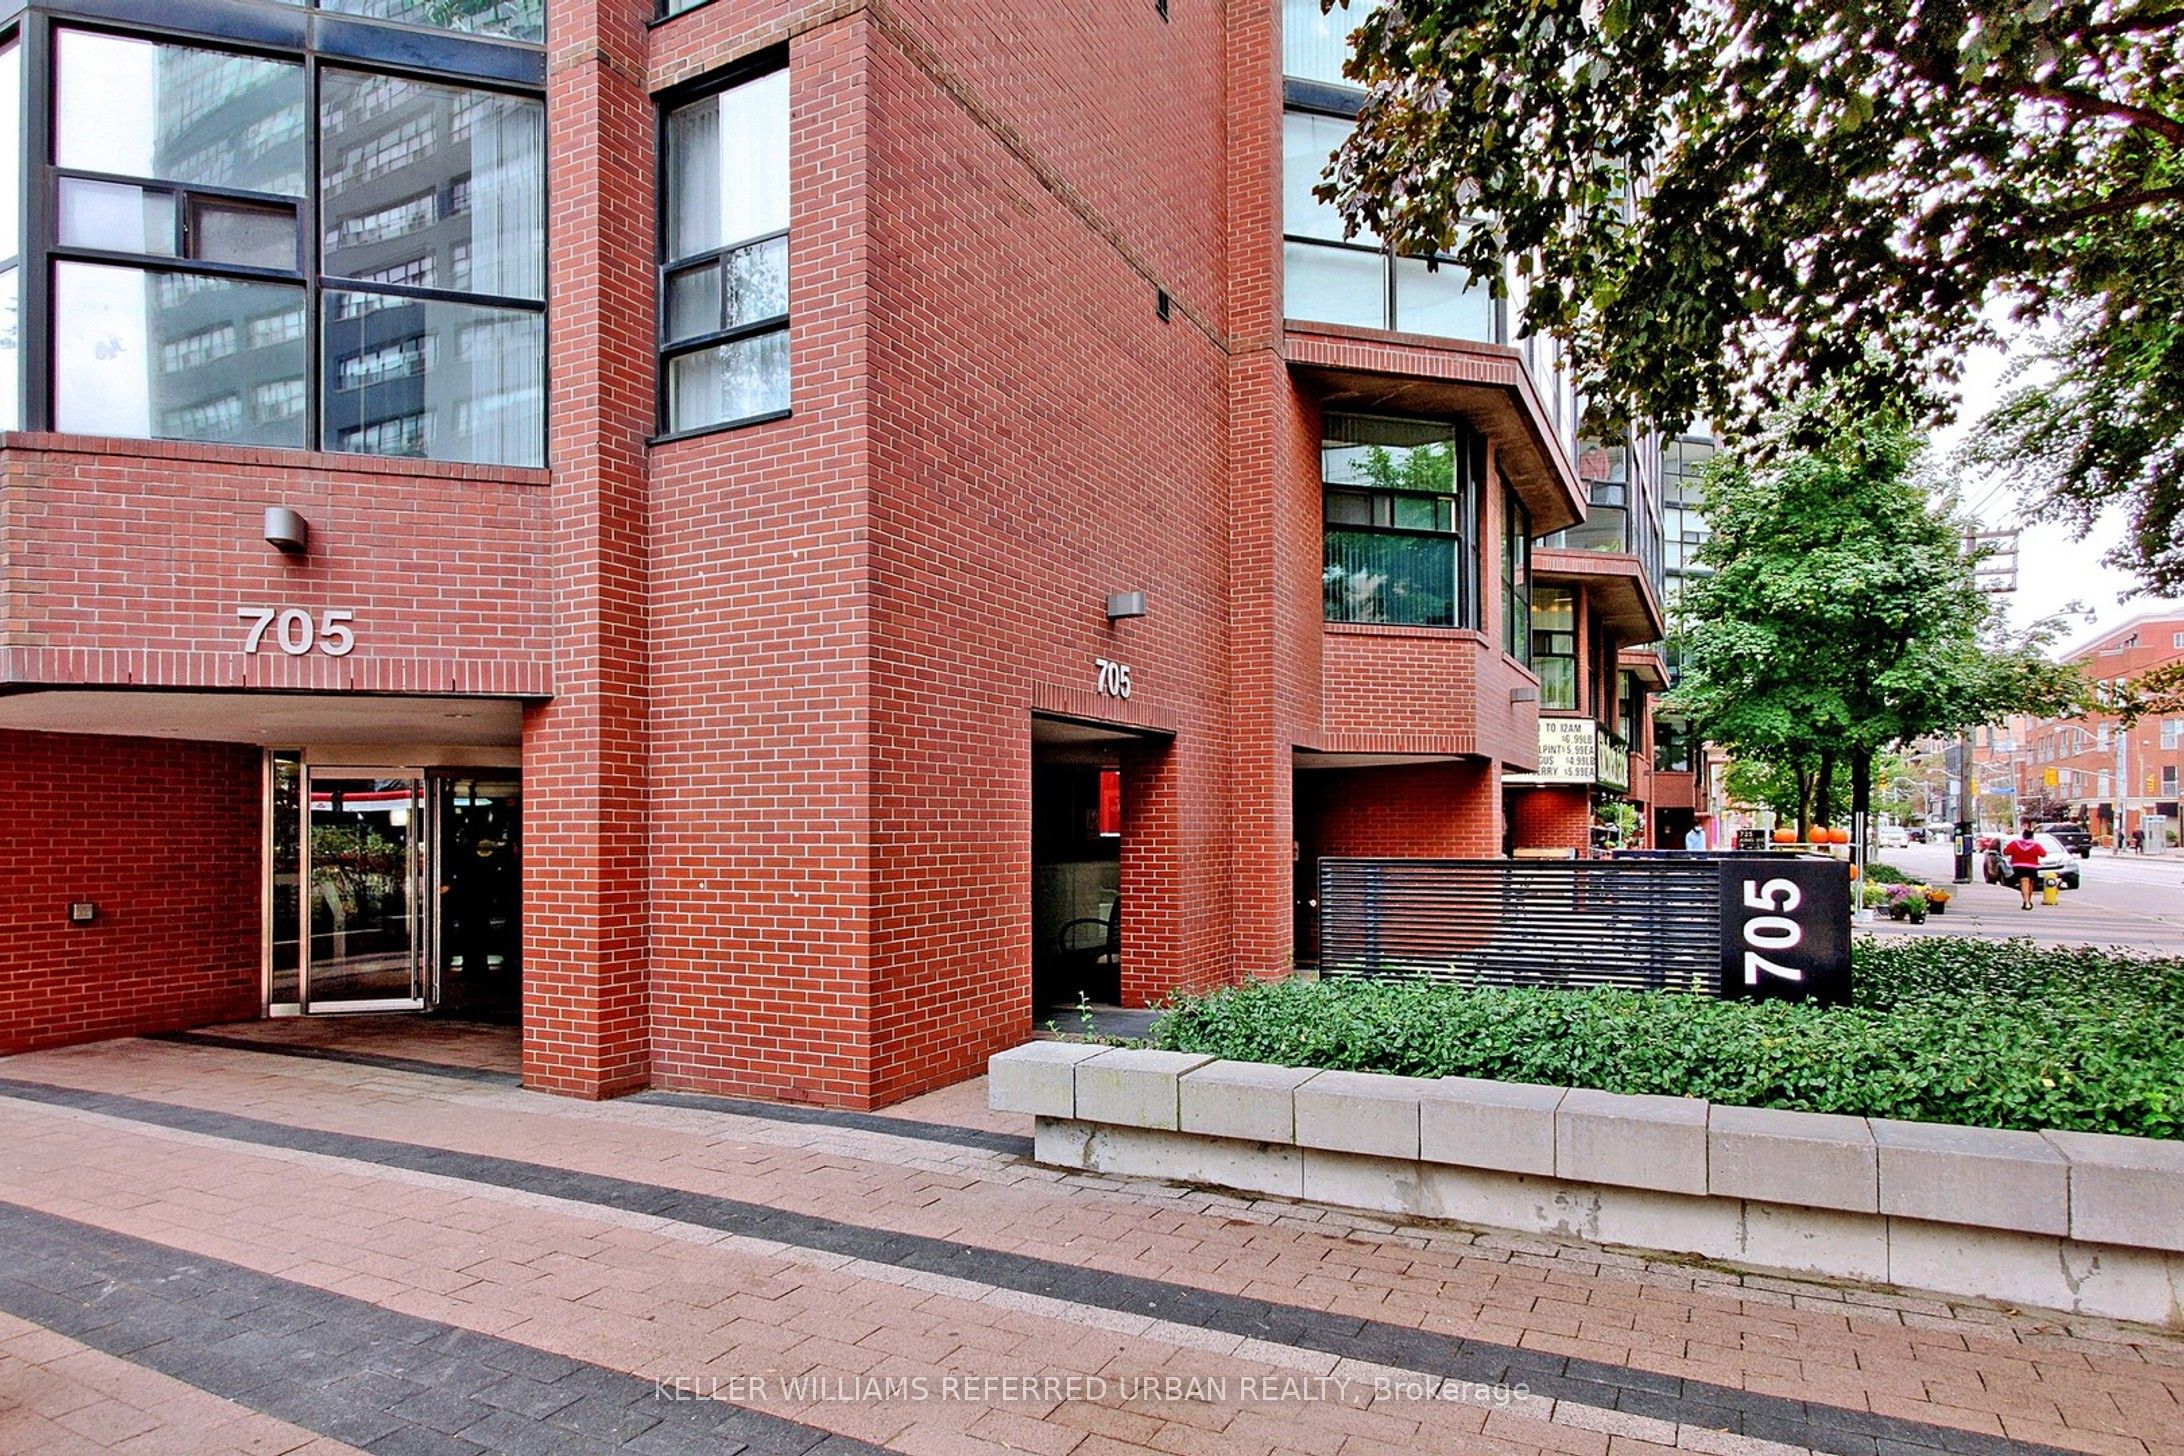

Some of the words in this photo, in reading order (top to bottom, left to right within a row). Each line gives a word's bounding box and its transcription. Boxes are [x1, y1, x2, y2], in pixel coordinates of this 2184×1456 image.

[237, 606, 355, 656] 705
[1095, 657, 1131, 699] 705
[1546, 723, 1556, 732] TO
[1560, 723, 1582, 733] 12AM
[1743, 878, 1802, 985] 705
